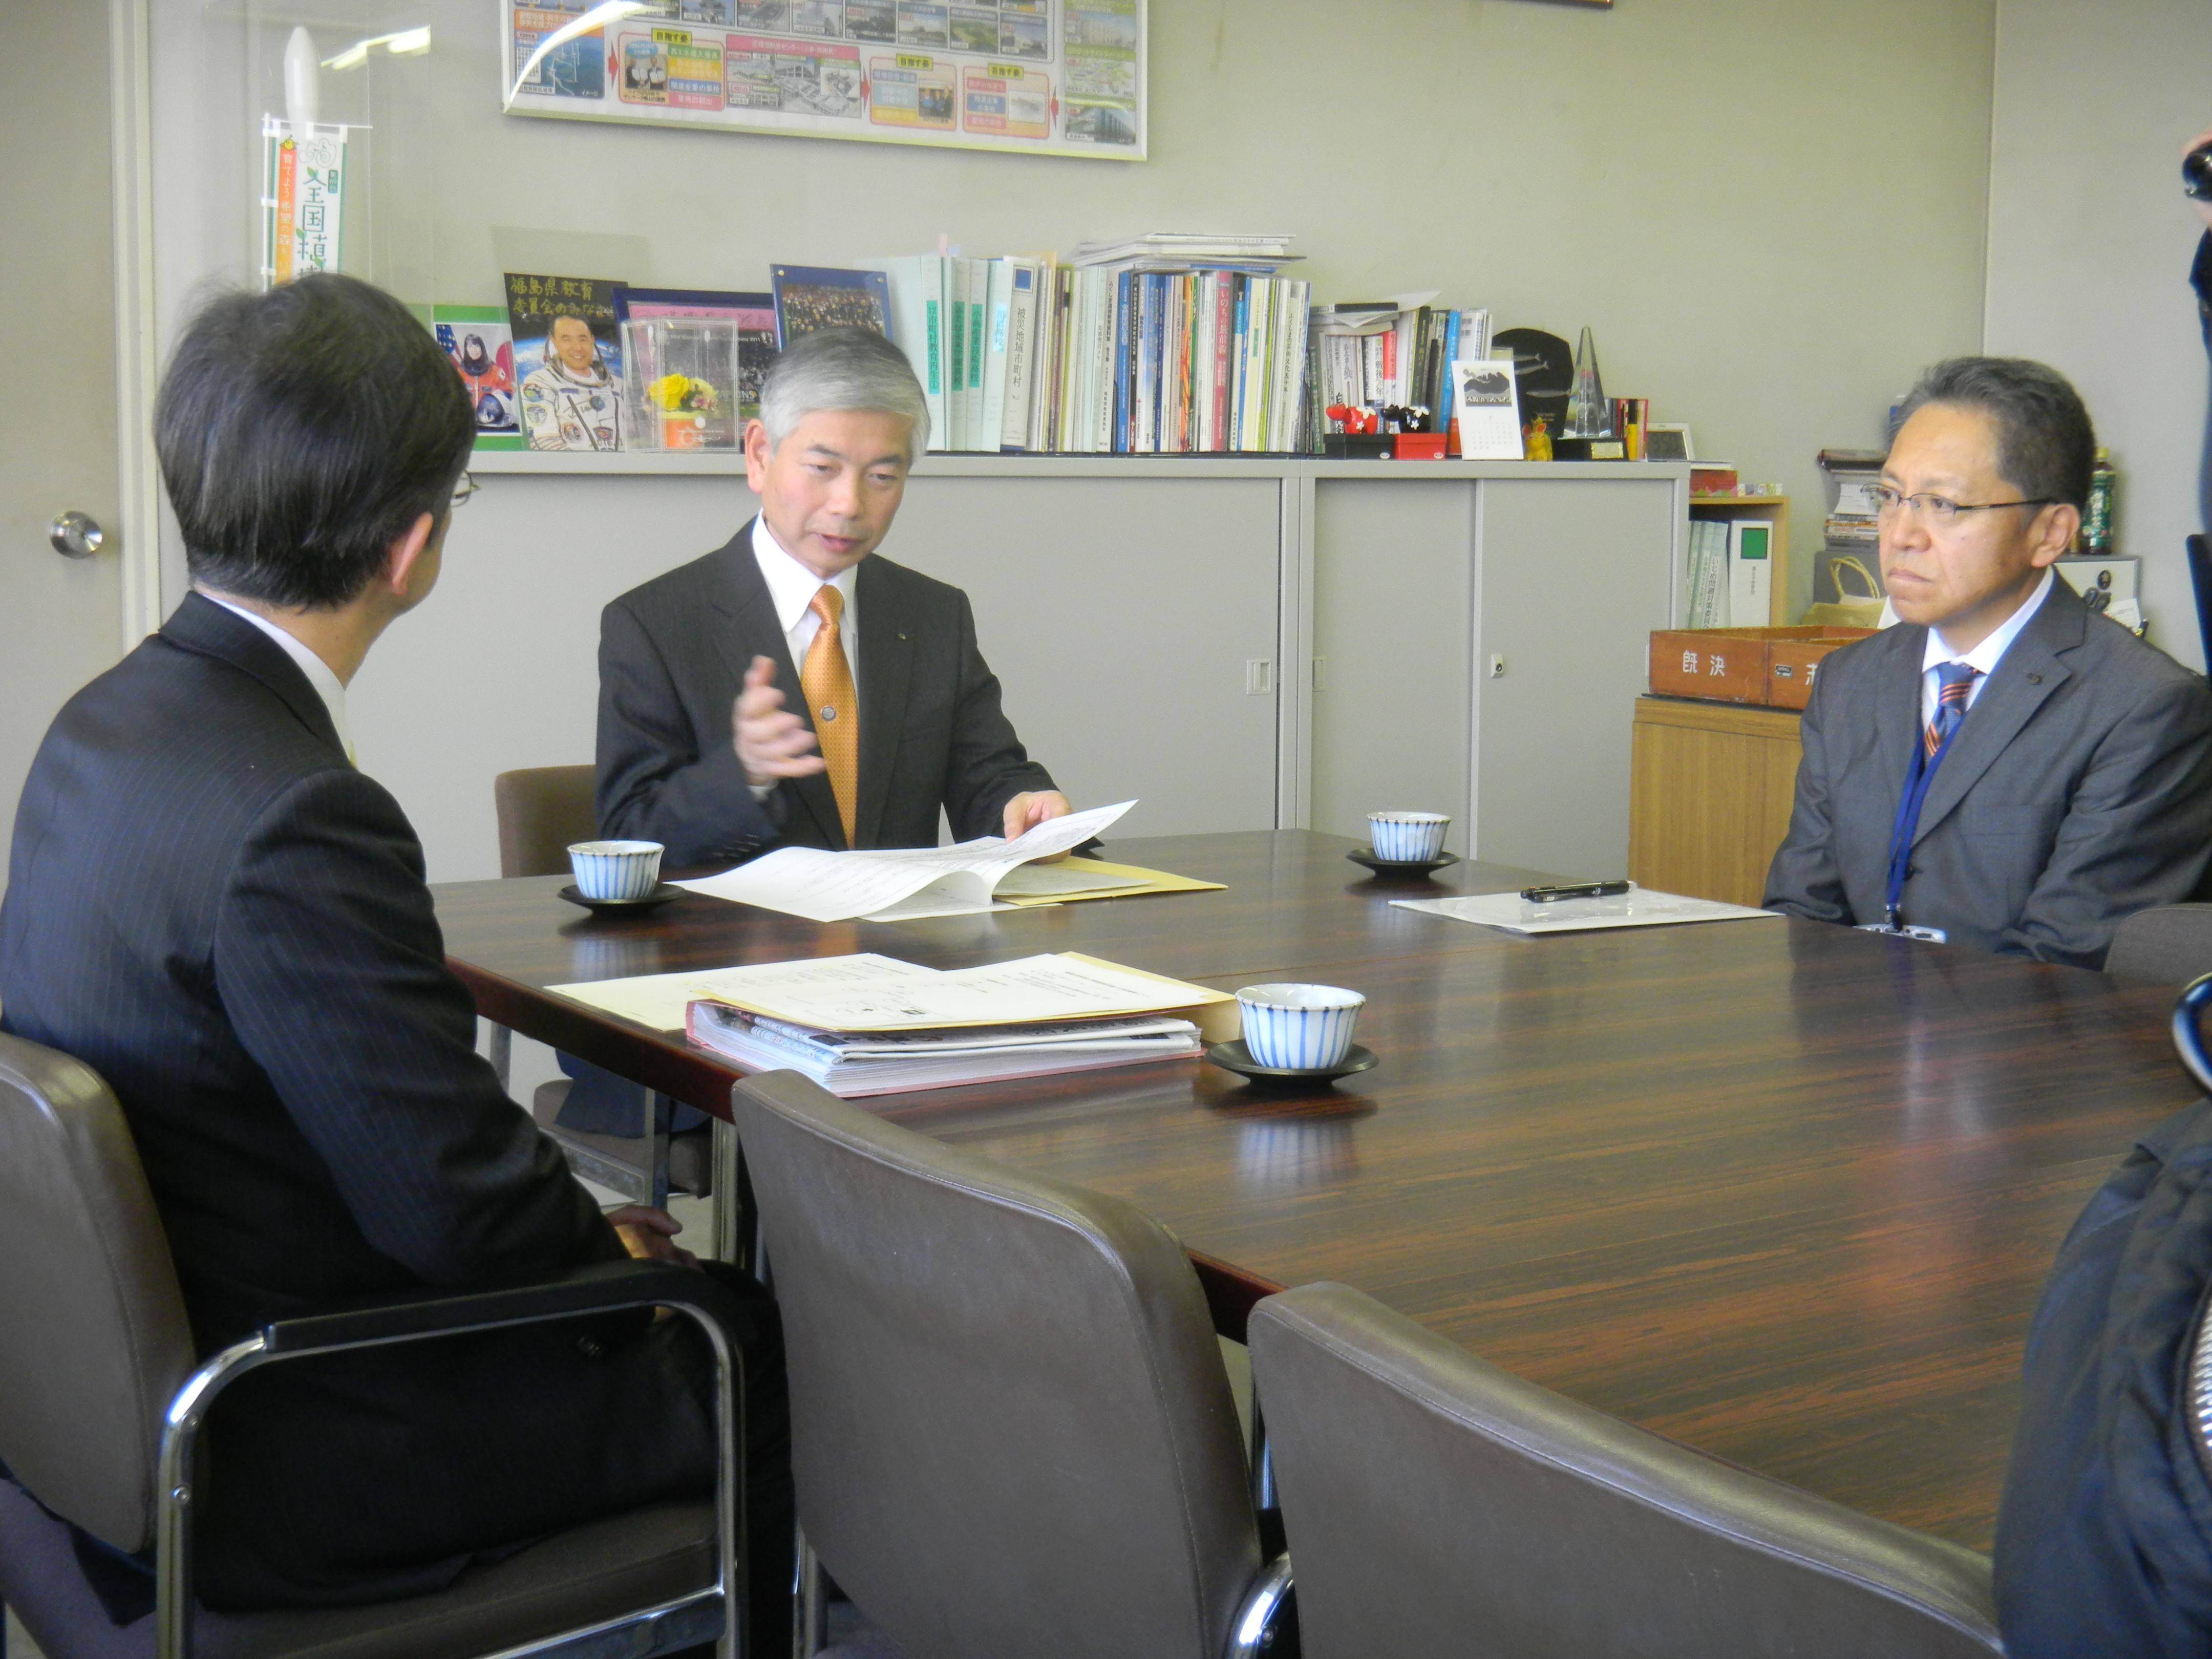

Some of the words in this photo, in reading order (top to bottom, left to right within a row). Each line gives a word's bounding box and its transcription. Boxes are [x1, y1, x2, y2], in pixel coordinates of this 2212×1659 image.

[511, 276, 593, 301] 福島県教育
[1012, 307, 1026, 388] 被災地域市町村
[1218, 290, 1229, 355] いのちの最前線
[1283, 313, 1294, 393] ふくしまの芸術文化五十年
[1682, 650, 1725, 677] 既決
